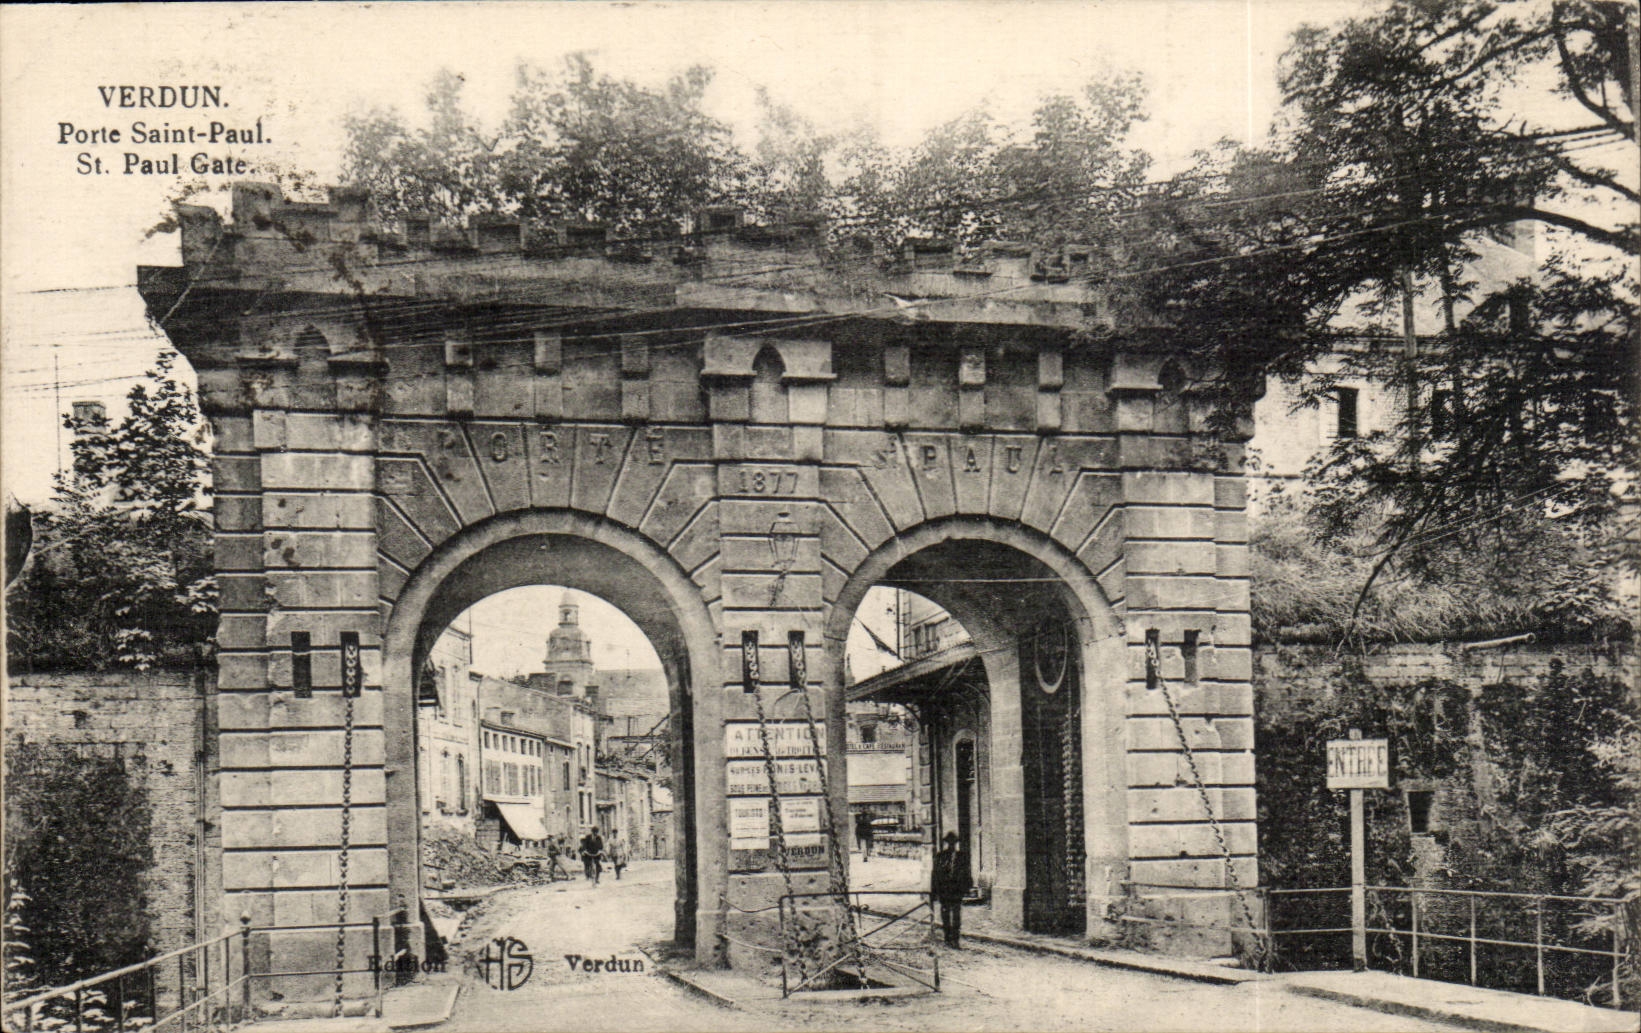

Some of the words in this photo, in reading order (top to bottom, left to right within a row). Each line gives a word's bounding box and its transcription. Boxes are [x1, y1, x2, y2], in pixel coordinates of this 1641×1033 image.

[918, 443, 1064, 475] PAUL
[738, 470, 799, 494] 1877
[735, 726, 825, 742] ATTENTION
